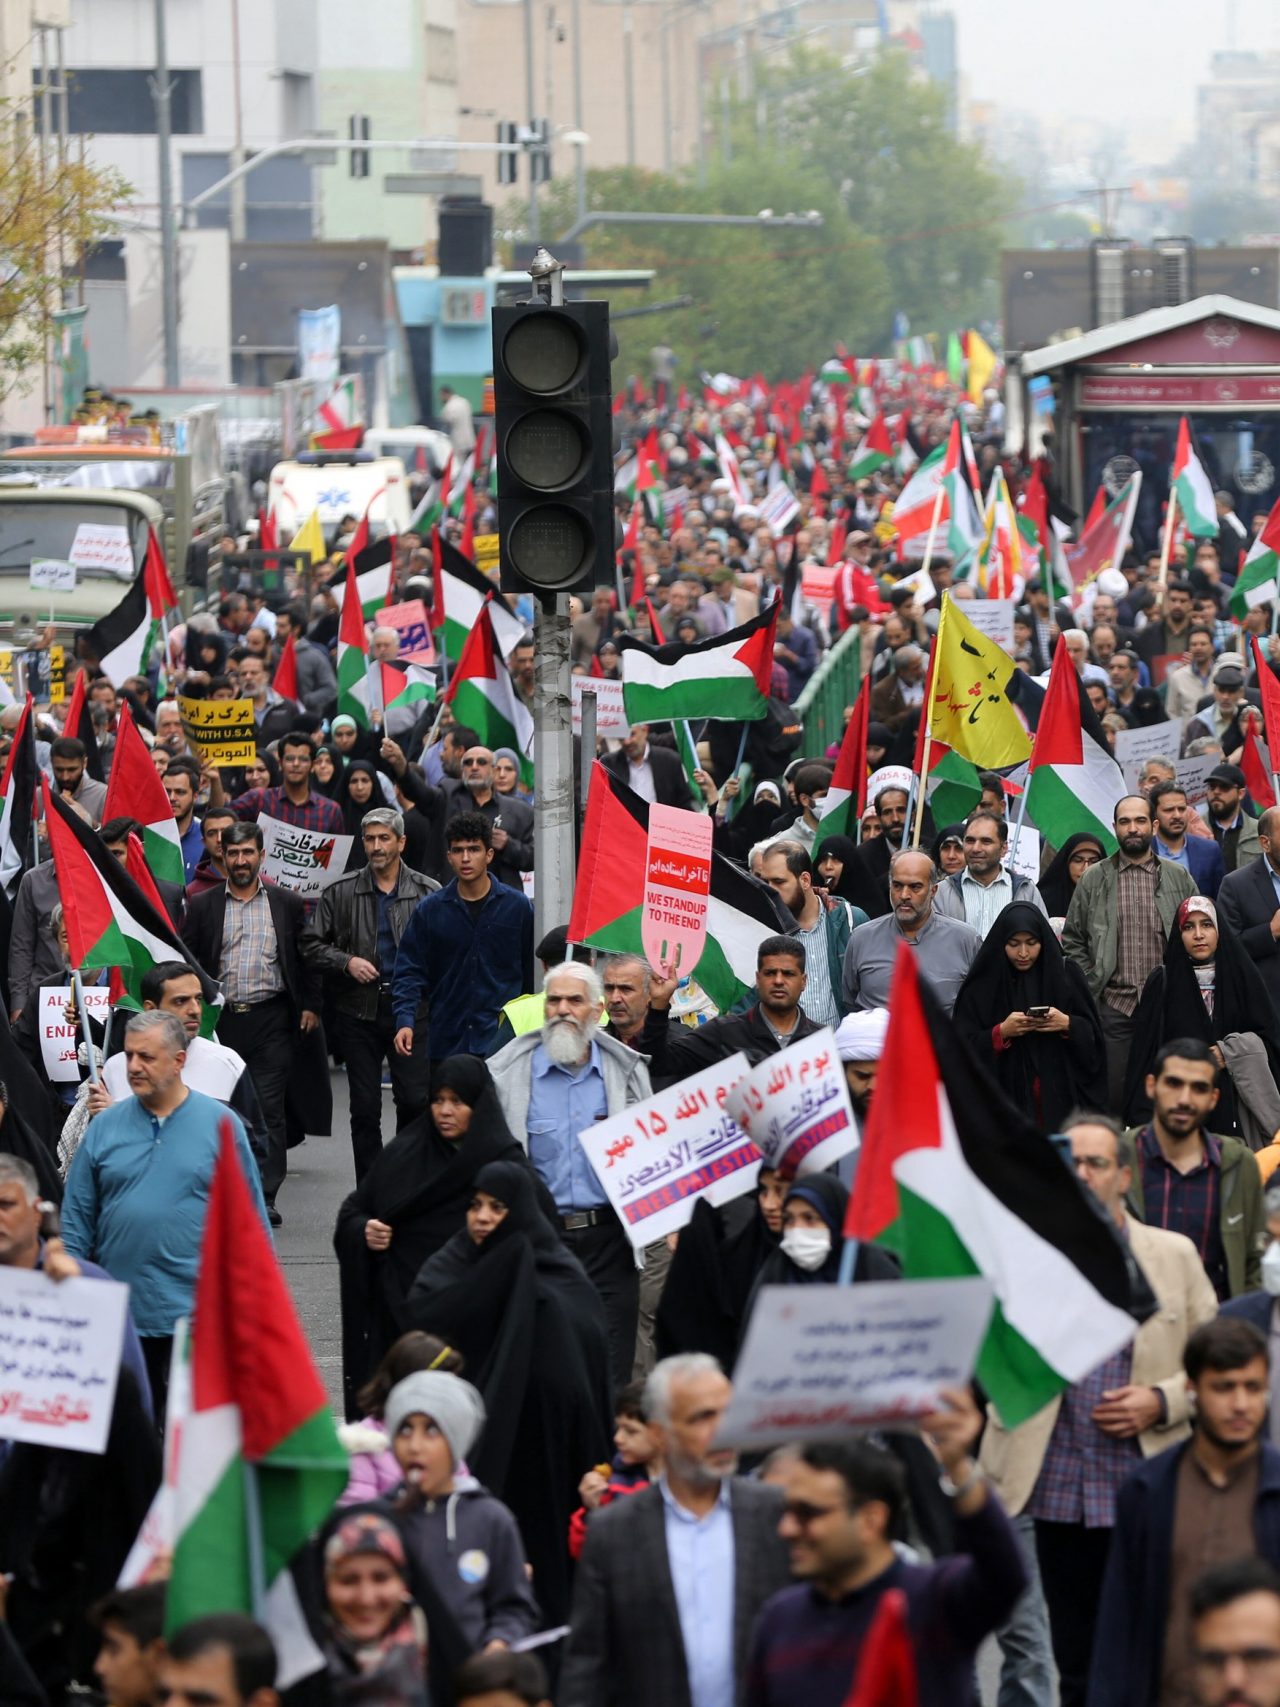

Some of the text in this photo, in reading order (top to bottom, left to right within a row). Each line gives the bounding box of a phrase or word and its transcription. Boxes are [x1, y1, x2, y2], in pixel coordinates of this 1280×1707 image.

[212, 745, 251, 762] الموت
[281, 868, 309, 879] شکست
[647, 891, 663, 906] WE
[649, 908, 701, 930] TO THE END
[46, 1024, 77, 1039] END
[767, 1064, 792, 1096] الله
[675, 1088, 709, 1121] الله
[635, 1110, 668, 1141] ۱۵
[604, 1135, 635, 1169] مهر
[623, 1141, 763, 1225] FREE PALESTIN
